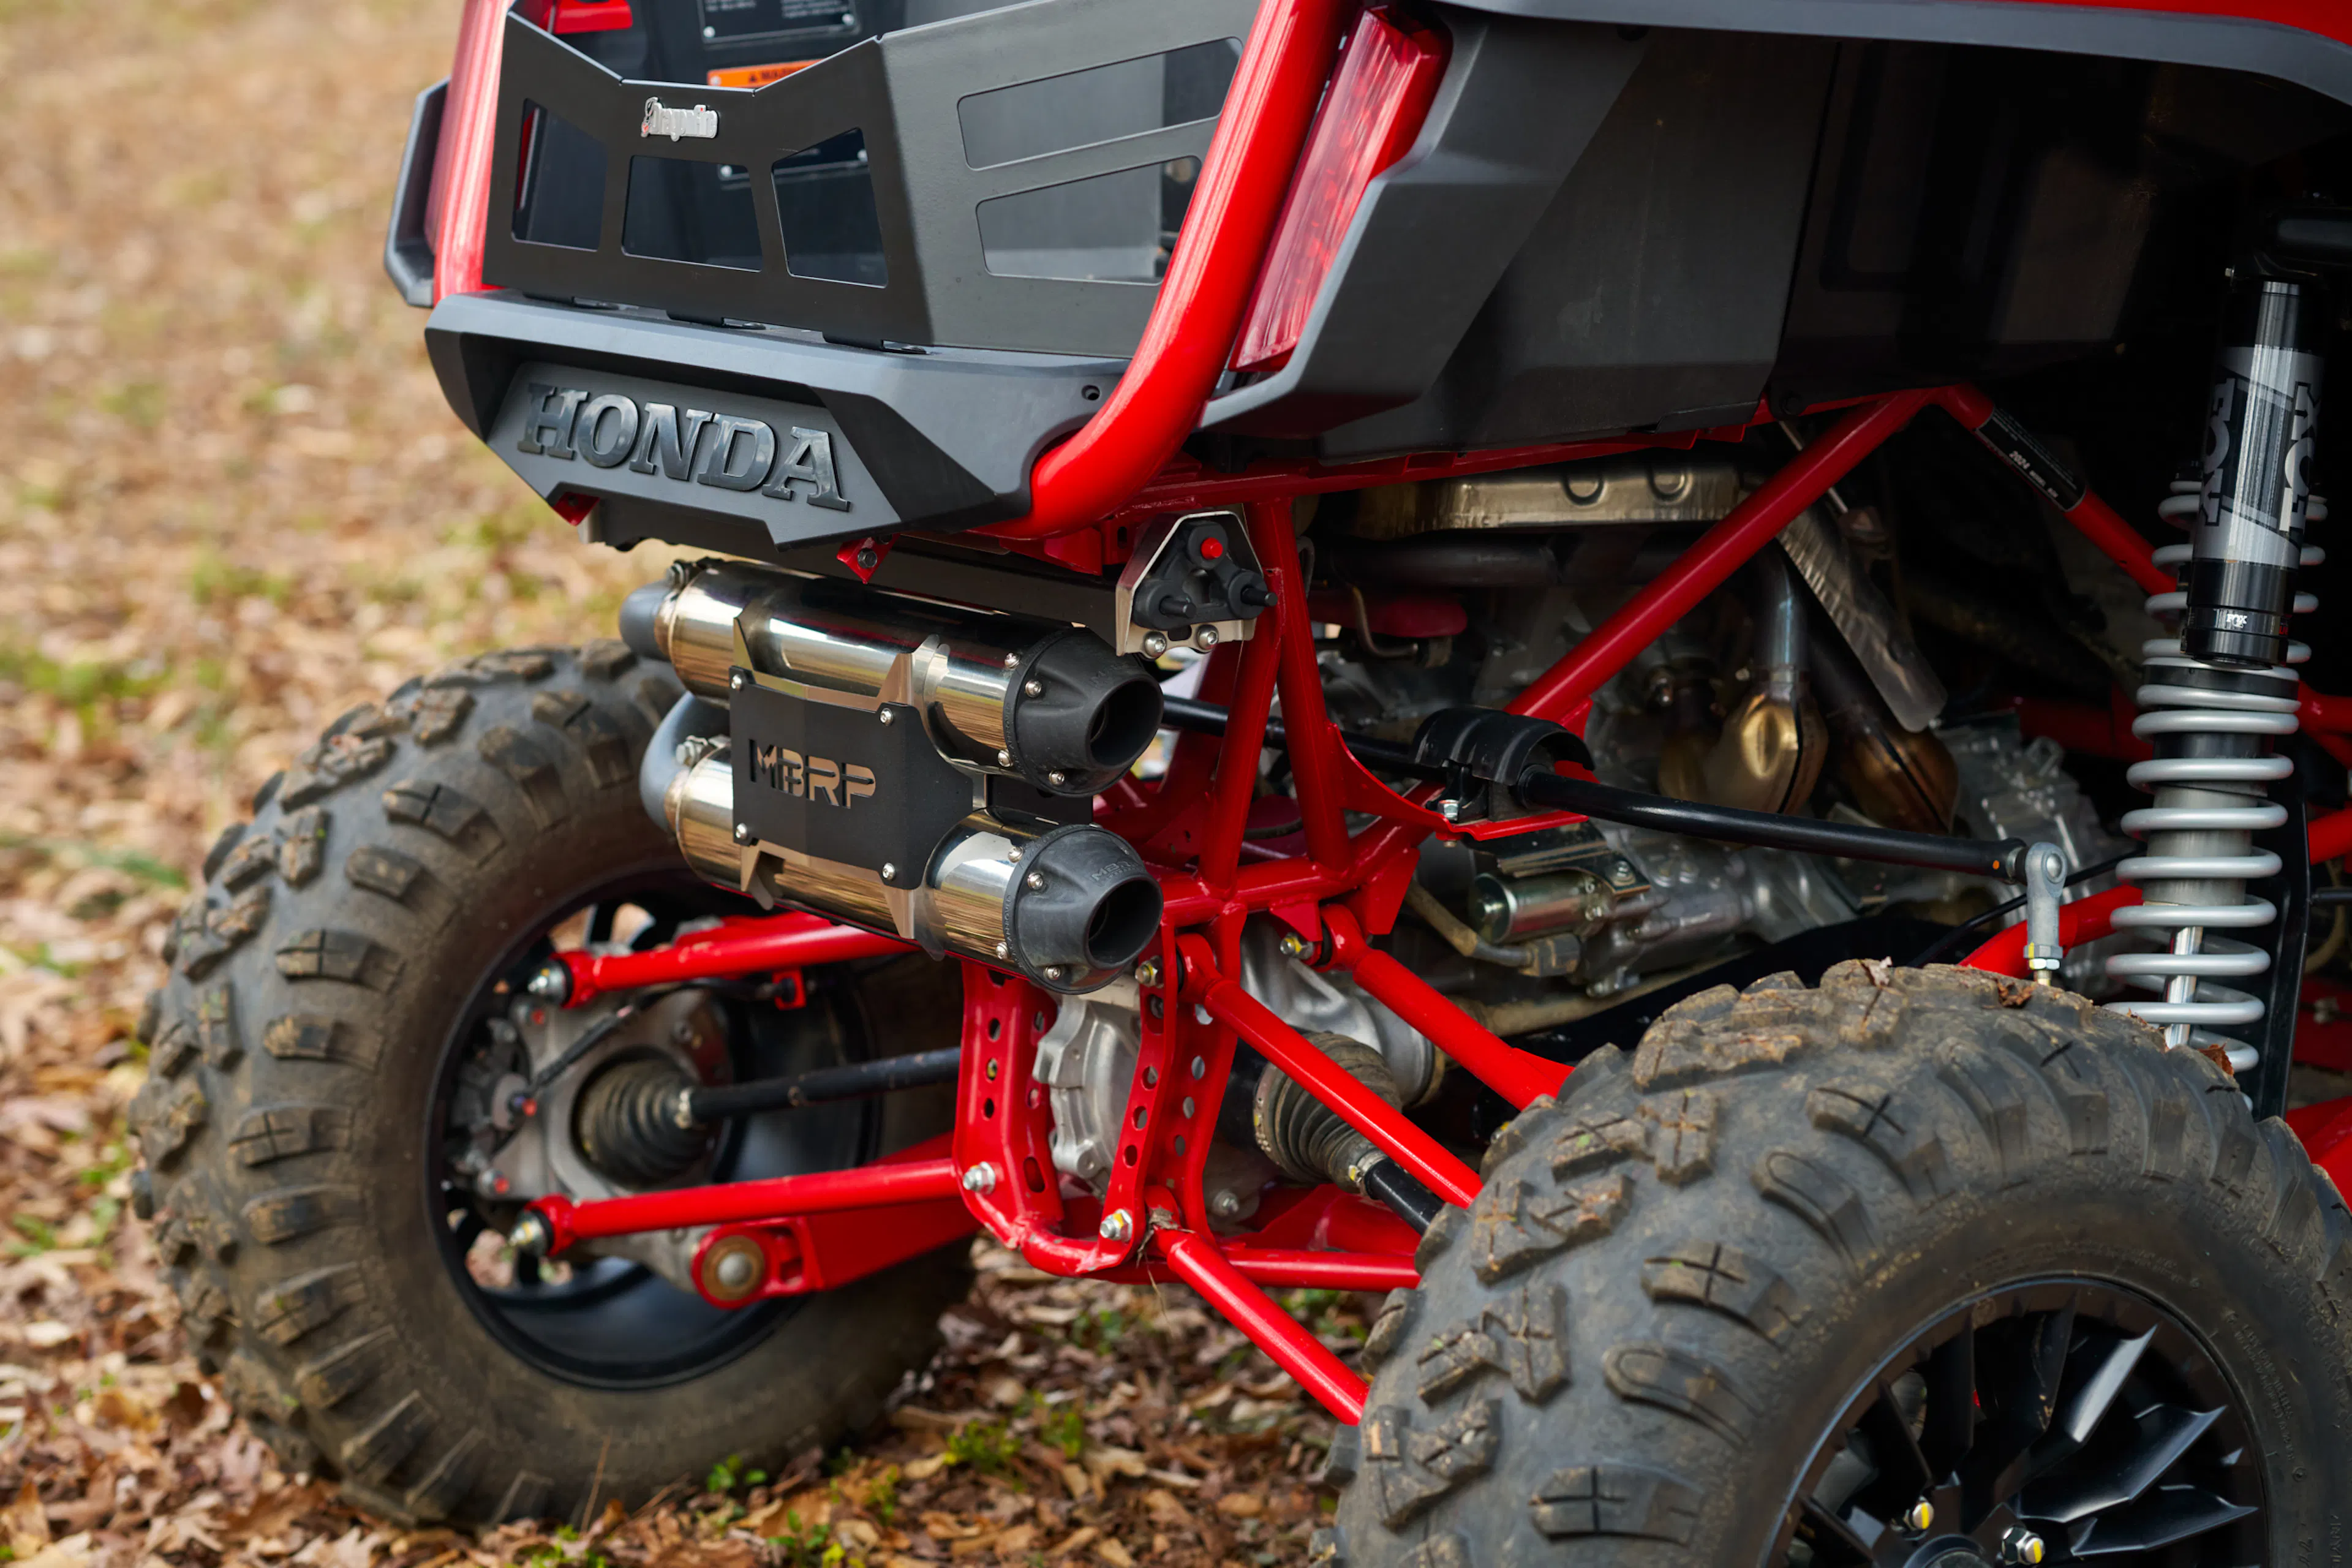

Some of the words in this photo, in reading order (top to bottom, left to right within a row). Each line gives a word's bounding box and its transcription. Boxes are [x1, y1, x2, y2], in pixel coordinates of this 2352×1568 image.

[517, 382, 852, 512] HONDA
[2009, 451, 2030, 469] 2024
[2226, 613, 2248, 629] FOX
[748, 739, 876, 809] MBRP
